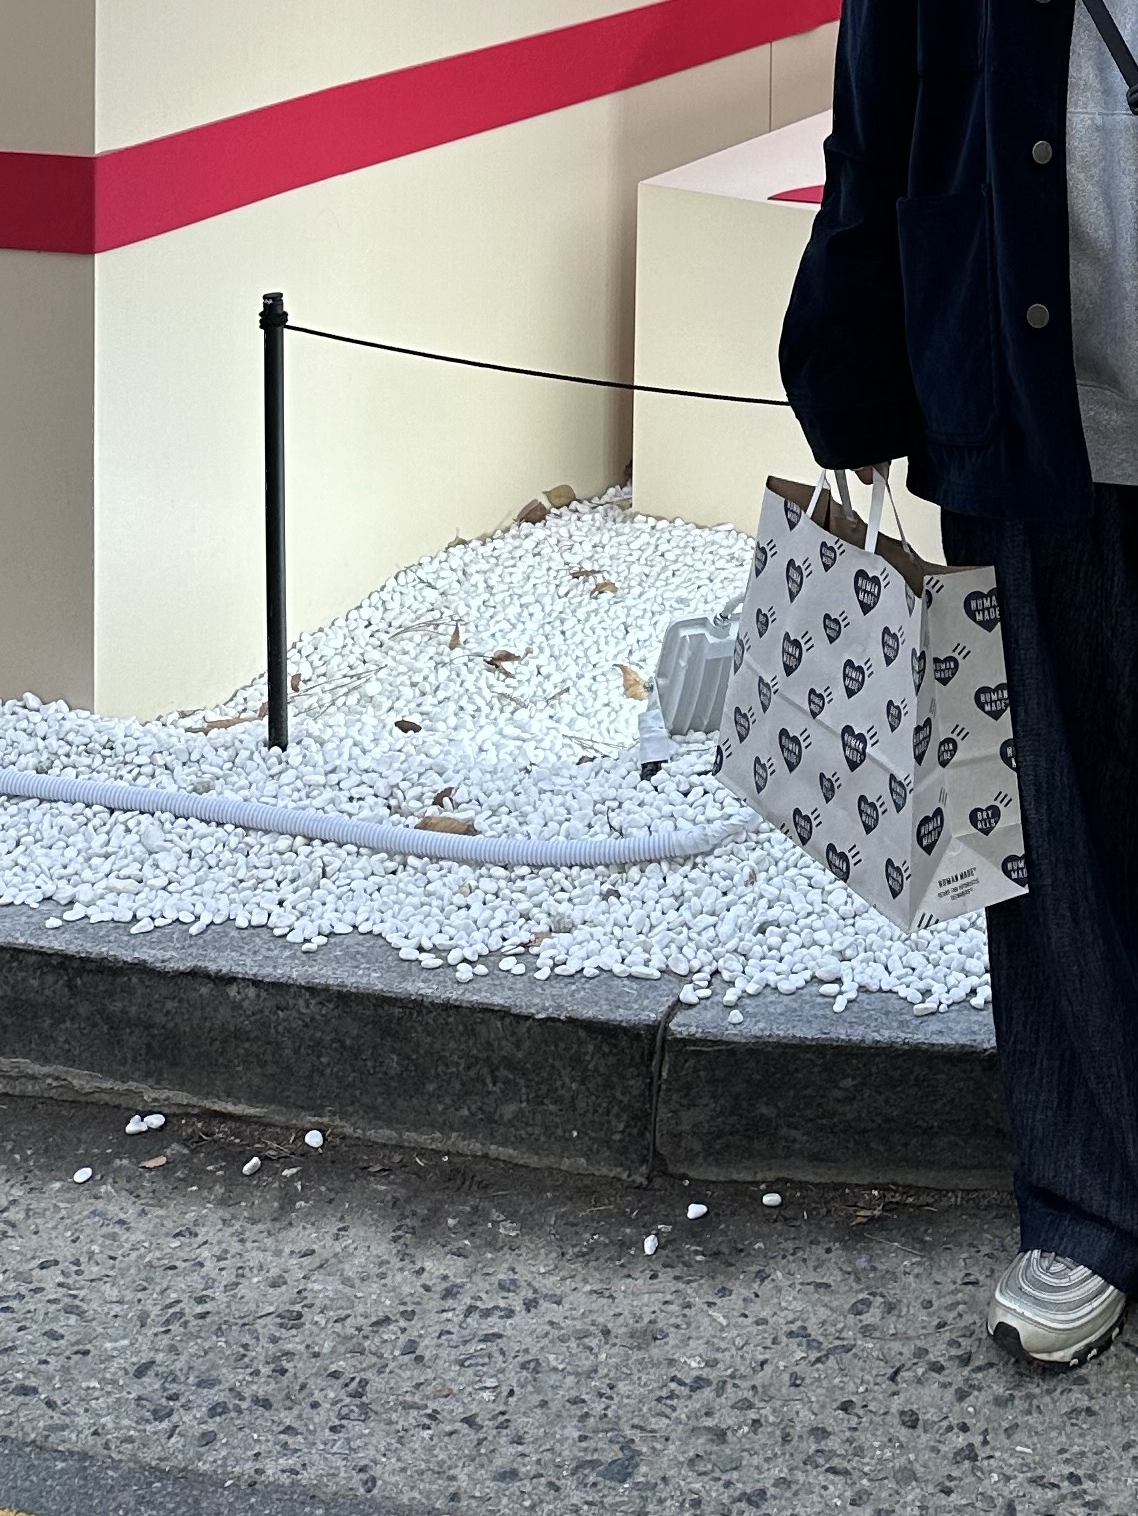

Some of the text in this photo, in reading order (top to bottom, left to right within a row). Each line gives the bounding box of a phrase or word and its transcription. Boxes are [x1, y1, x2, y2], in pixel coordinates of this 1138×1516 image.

[857, 576, 879, 597] HUMAN
[970, 595, 998, 611] HUMA
[975, 607, 1000, 622] MADE
[980, 689, 1009, 703] HUMAN
[984, 700, 1006, 712] MADE
[977, 810, 993, 821] DRY
[977, 818, 996, 830] ALLS
[1007, 858, 1025, 871] HUM
[1011, 868, 1028, 880] MAD
